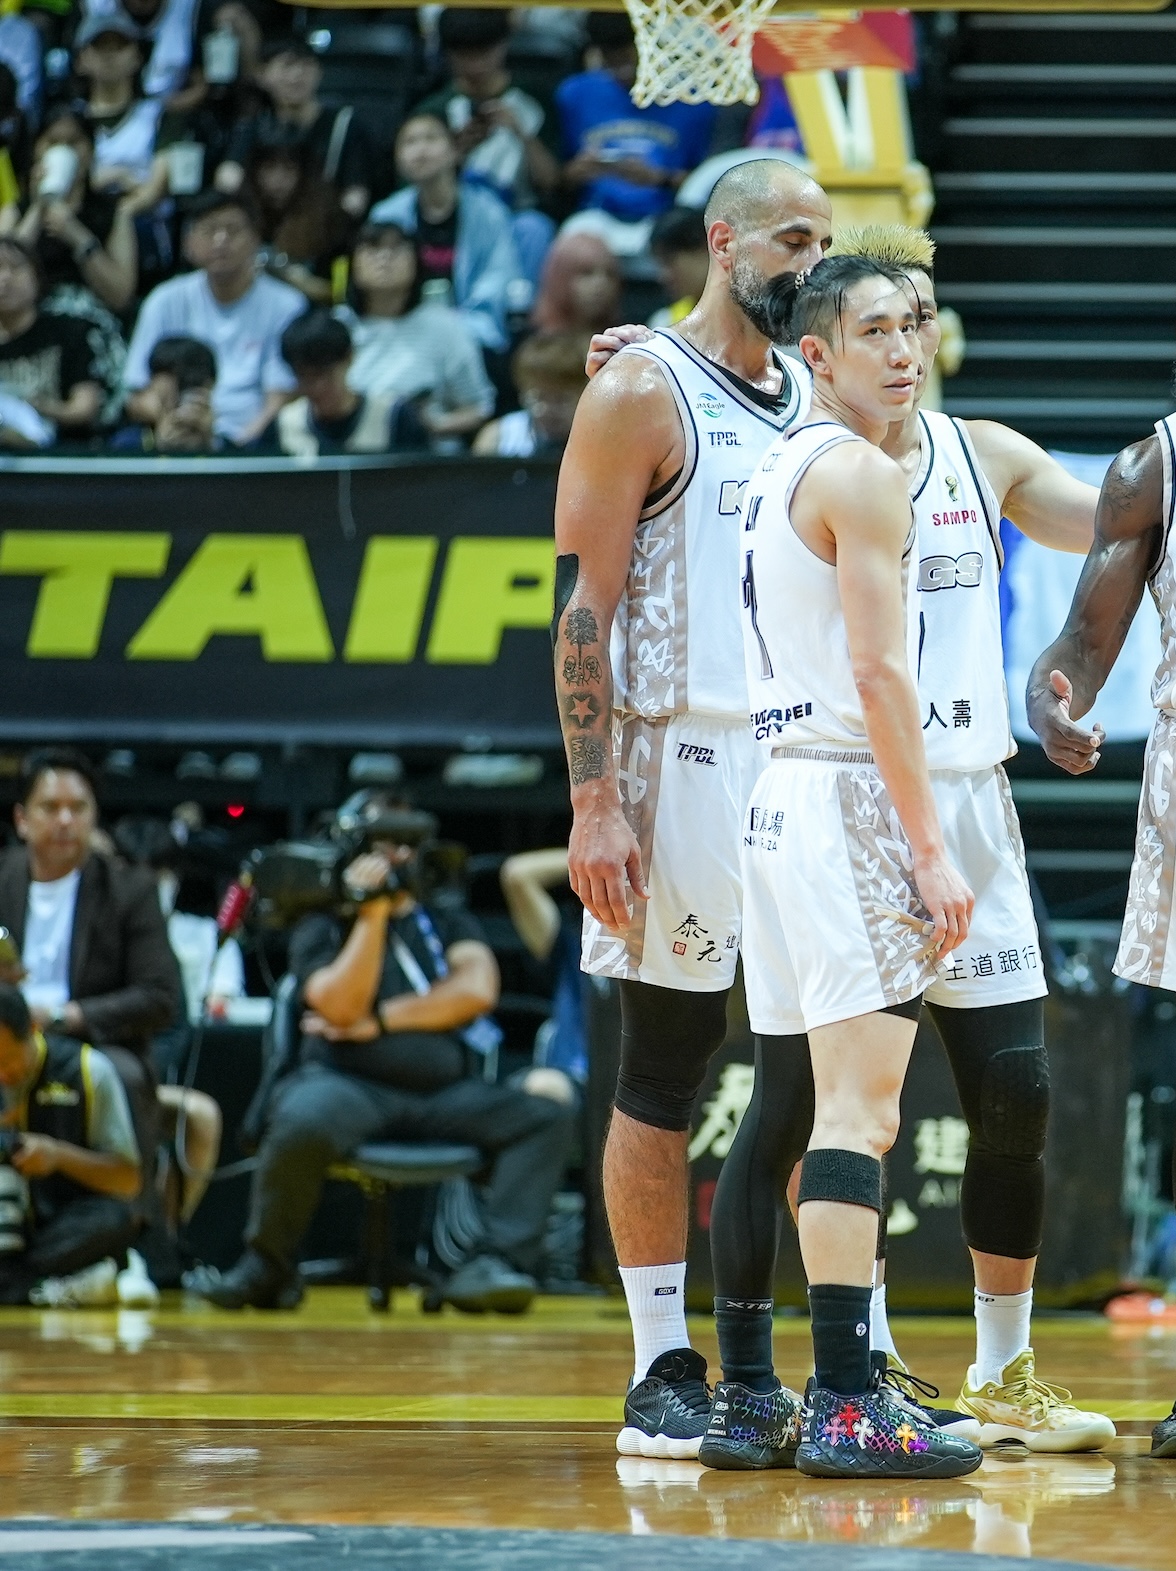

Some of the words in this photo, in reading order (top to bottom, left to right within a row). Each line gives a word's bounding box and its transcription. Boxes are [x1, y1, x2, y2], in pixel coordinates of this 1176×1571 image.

[932, 509, 977, 526] SAMPO
[917, 552, 983, 591] GS
[0, 532, 557, 664] TAIP
[922, 699, 972, 730] 人壽
[676, 742, 718, 766] TPBL
[945, 945, 1037, 981] 王道銀行
[726, 1300, 772, 1310] XTEP
[974, 1295, 995, 1304] EP
